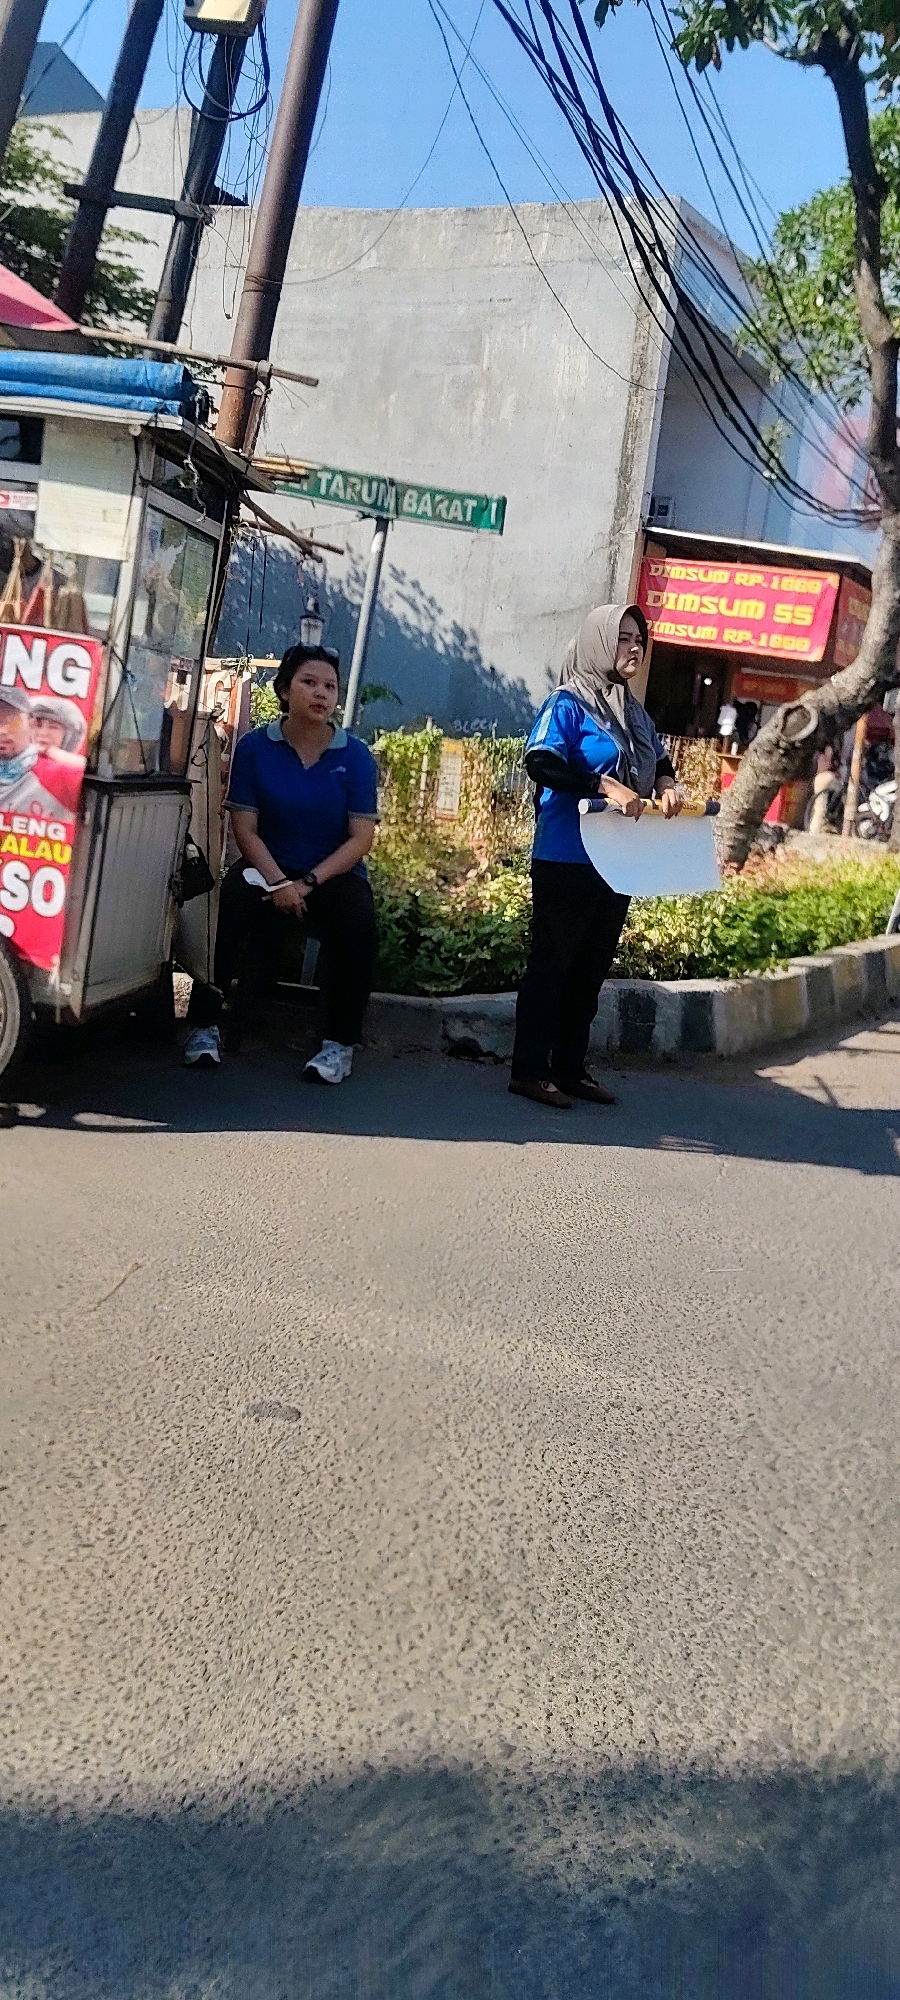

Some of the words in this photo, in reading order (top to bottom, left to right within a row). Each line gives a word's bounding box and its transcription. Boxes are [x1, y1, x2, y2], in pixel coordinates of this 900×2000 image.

[317, 471, 397, 514] TARUM
[402, 488, 478, 522] BARAT
[649, 564, 730, 584] DIMSUM
[645, 590, 767, 621] DIMSUM
[1, 634, 93, 699] NG
[0, 812, 67, 842] LENG
[0, 833, 73, 865] ALAU
[0, 860, 66, 918] SO
